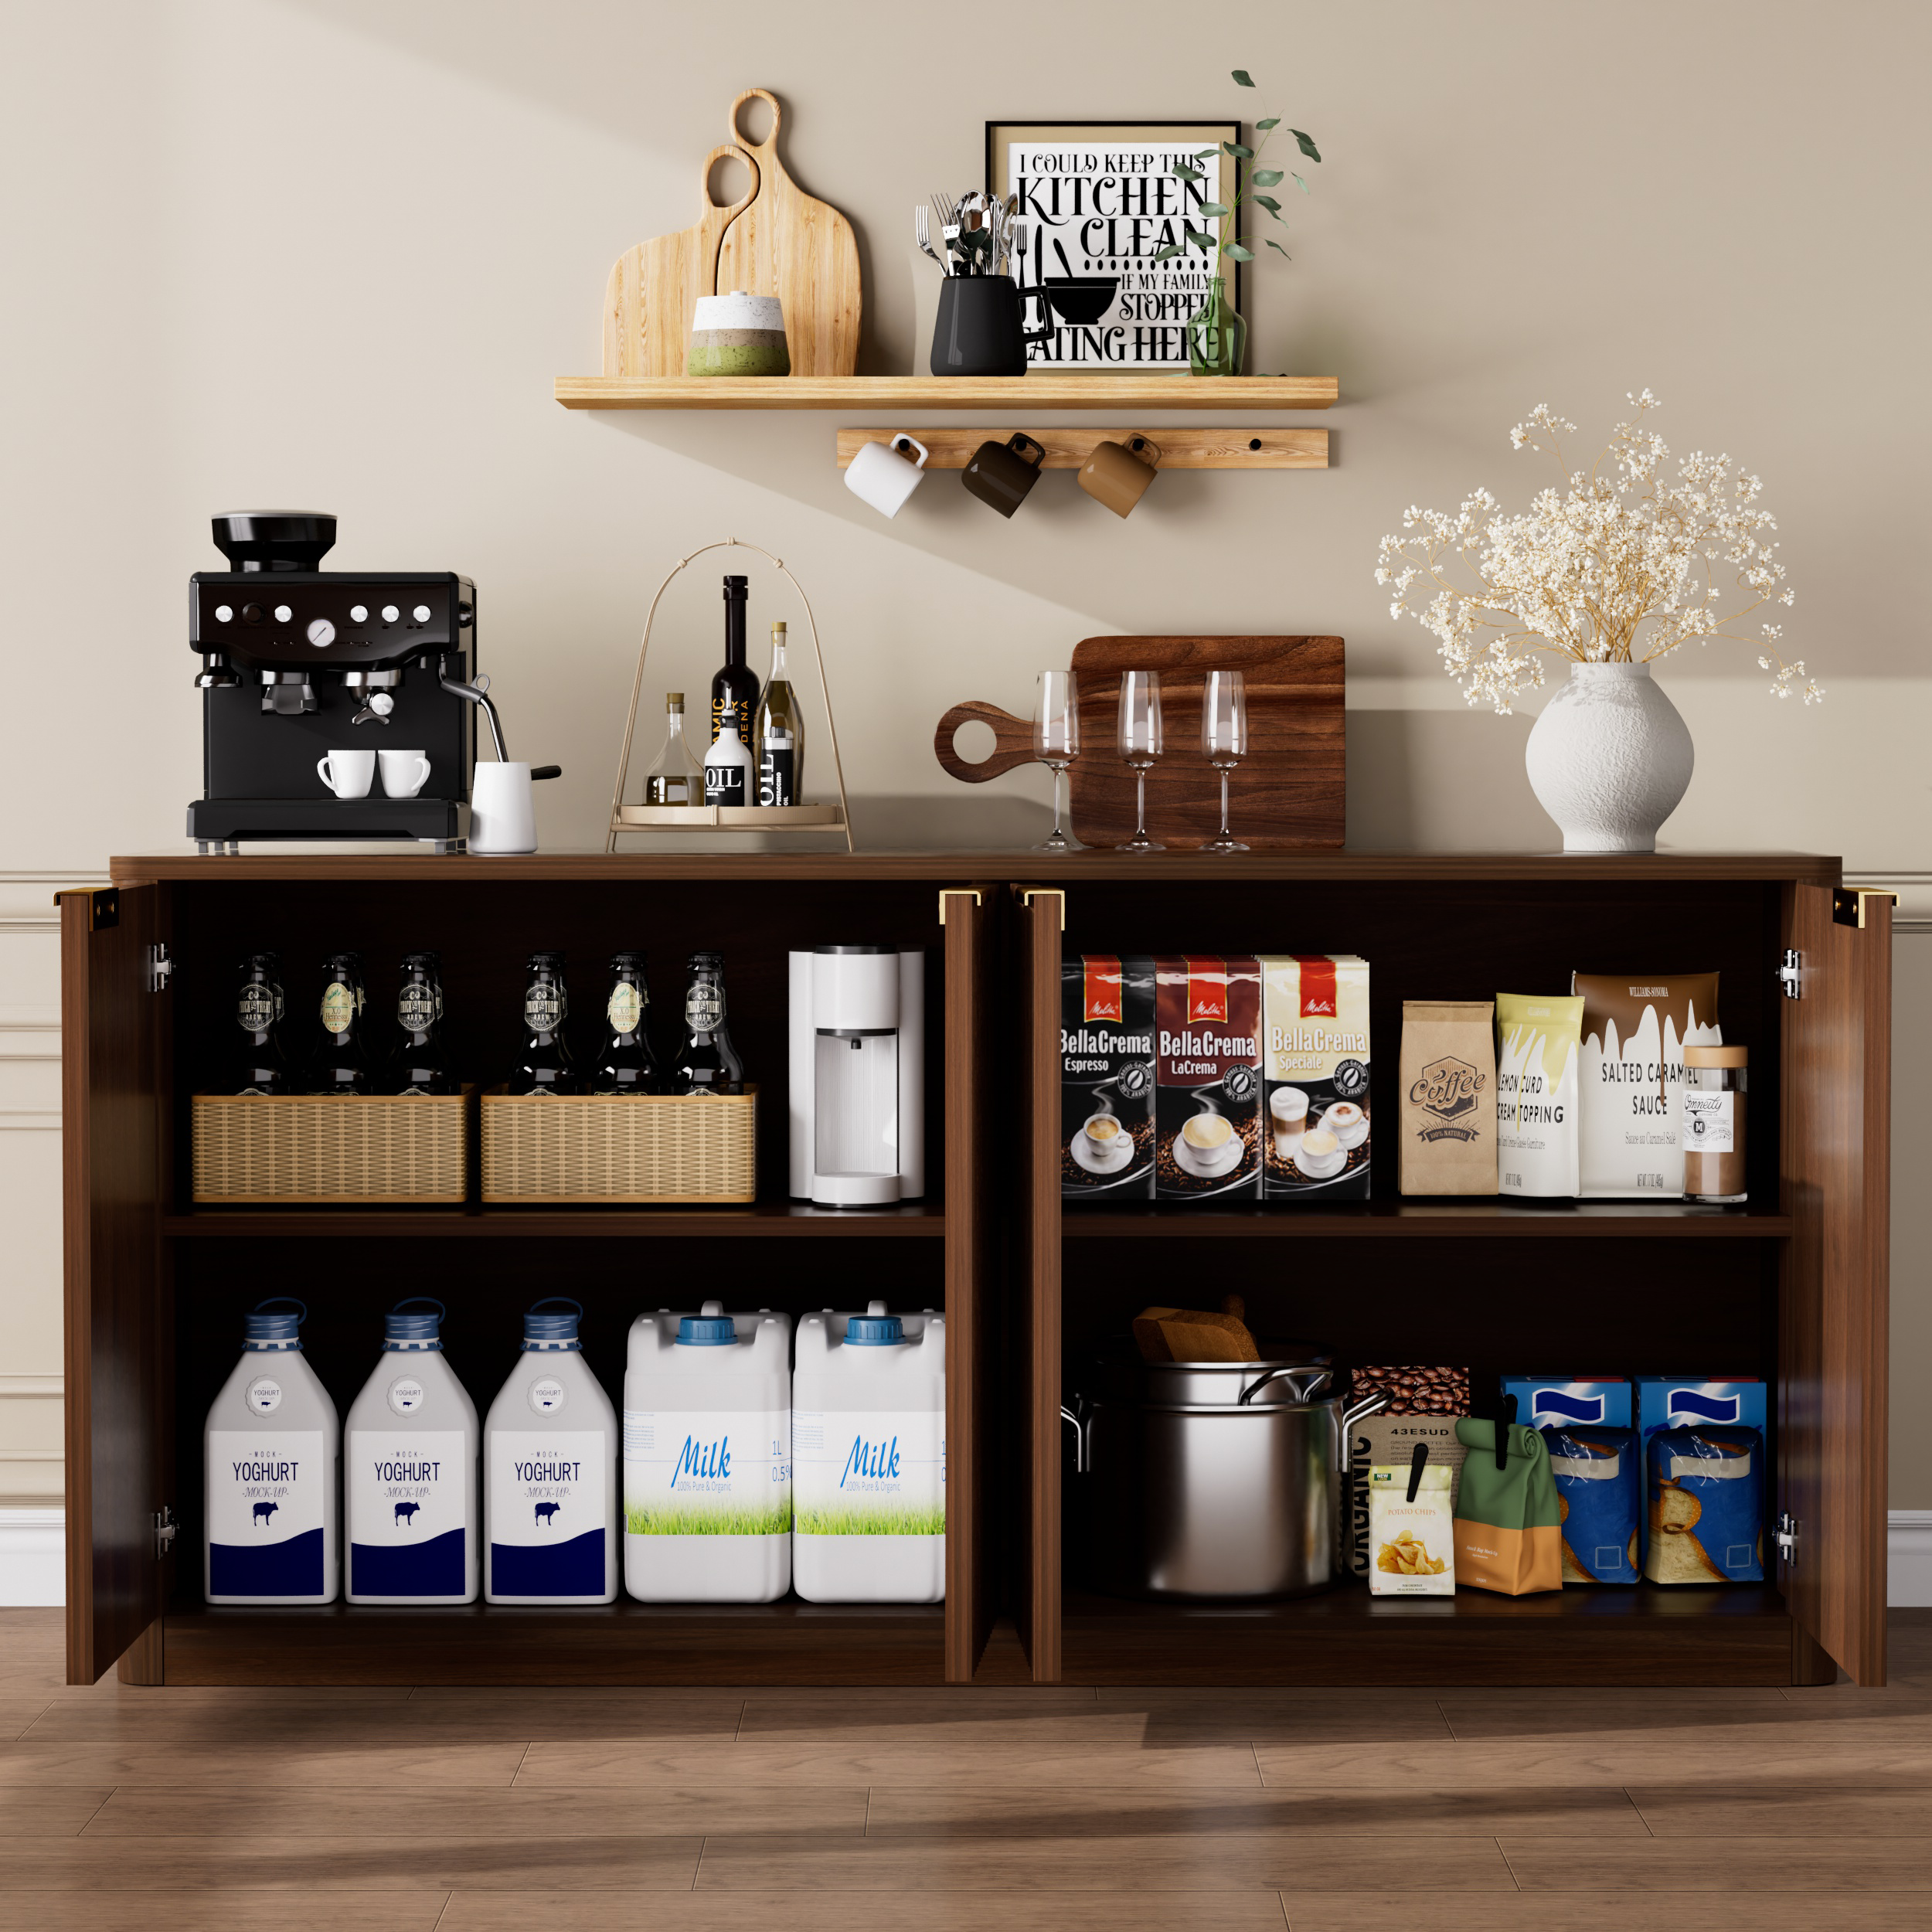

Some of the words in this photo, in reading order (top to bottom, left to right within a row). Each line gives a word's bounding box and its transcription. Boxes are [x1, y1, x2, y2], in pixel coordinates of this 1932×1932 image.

[1020, 154, 1026, 173] I
[1032, 154, 1097, 173] COULD
[1104, 154, 1154, 173] KEEP
[1016, 177, 1211, 226] KITCHEN
[1080, 218, 1211, 257] CLEAN
[1121, 274, 1134, 290] IF
[1138, 274, 1159, 290] MY
[1163, 274, 1212, 290] FAMILY
[706, 768, 741, 787] OIL
[760, 754, 774, 807] OIL
[1089, 1001, 1116, 1015] Melitta
[1192, 1001, 1221, 1015] Melitta
[1304, 998, 1332, 1013] Melitta
[1060, 1029, 1151, 1053] BellaCrema
[1160, 1031, 1257, 1056] BellaCrema
[1272, 1026, 1366, 1052] BellaCrema
[1065, 1057, 1109, 1073] Espresso
[1172, 1060, 1216, 1074] LaCrema
[1280, 1056, 1322, 1071] Speciale
[1602, 1063, 1642, 1083] SALTED
[1410, 1070, 1485, 1104] Coffee
[1498, 1073, 1519, 1092] LEMON
[1521, 1075, 1543, 1094] CURD
[1497, 1102, 1516, 1121] CREAM
[1519, 1104, 1563, 1124] TOPPING
[1632, 1095, 1667, 1115] SAUCE
[1430, 1131, 1444, 1139] 100%
[1444, 1130, 1467, 1139] NATURAL
[1695, 1122, 1703, 1132] M
[1646, 1131, 1665, 1145] Caramel
[773, 1440, 782, 1455] 1L
[671, 1434, 731, 1488] Milk
[840, 1434, 900, 1488] Milk
[233, 1462, 298, 1481] YOGHURT
[375, 1462, 440, 1481] YOGHURT
[515, 1462, 580, 1481] YOGHURT
[677, 1481, 692, 1492] 100%
[692, 1481, 704, 1492] Pure
[706, 1481, 710, 1492] &
[711, 1481, 732, 1494] Organic
[846, 1481, 861, 1492] 100%
[862, 1481, 873, 1492] Pure
[876, 1481, 879, 1492] &
[880, 1481, 900, 1494] Organic
